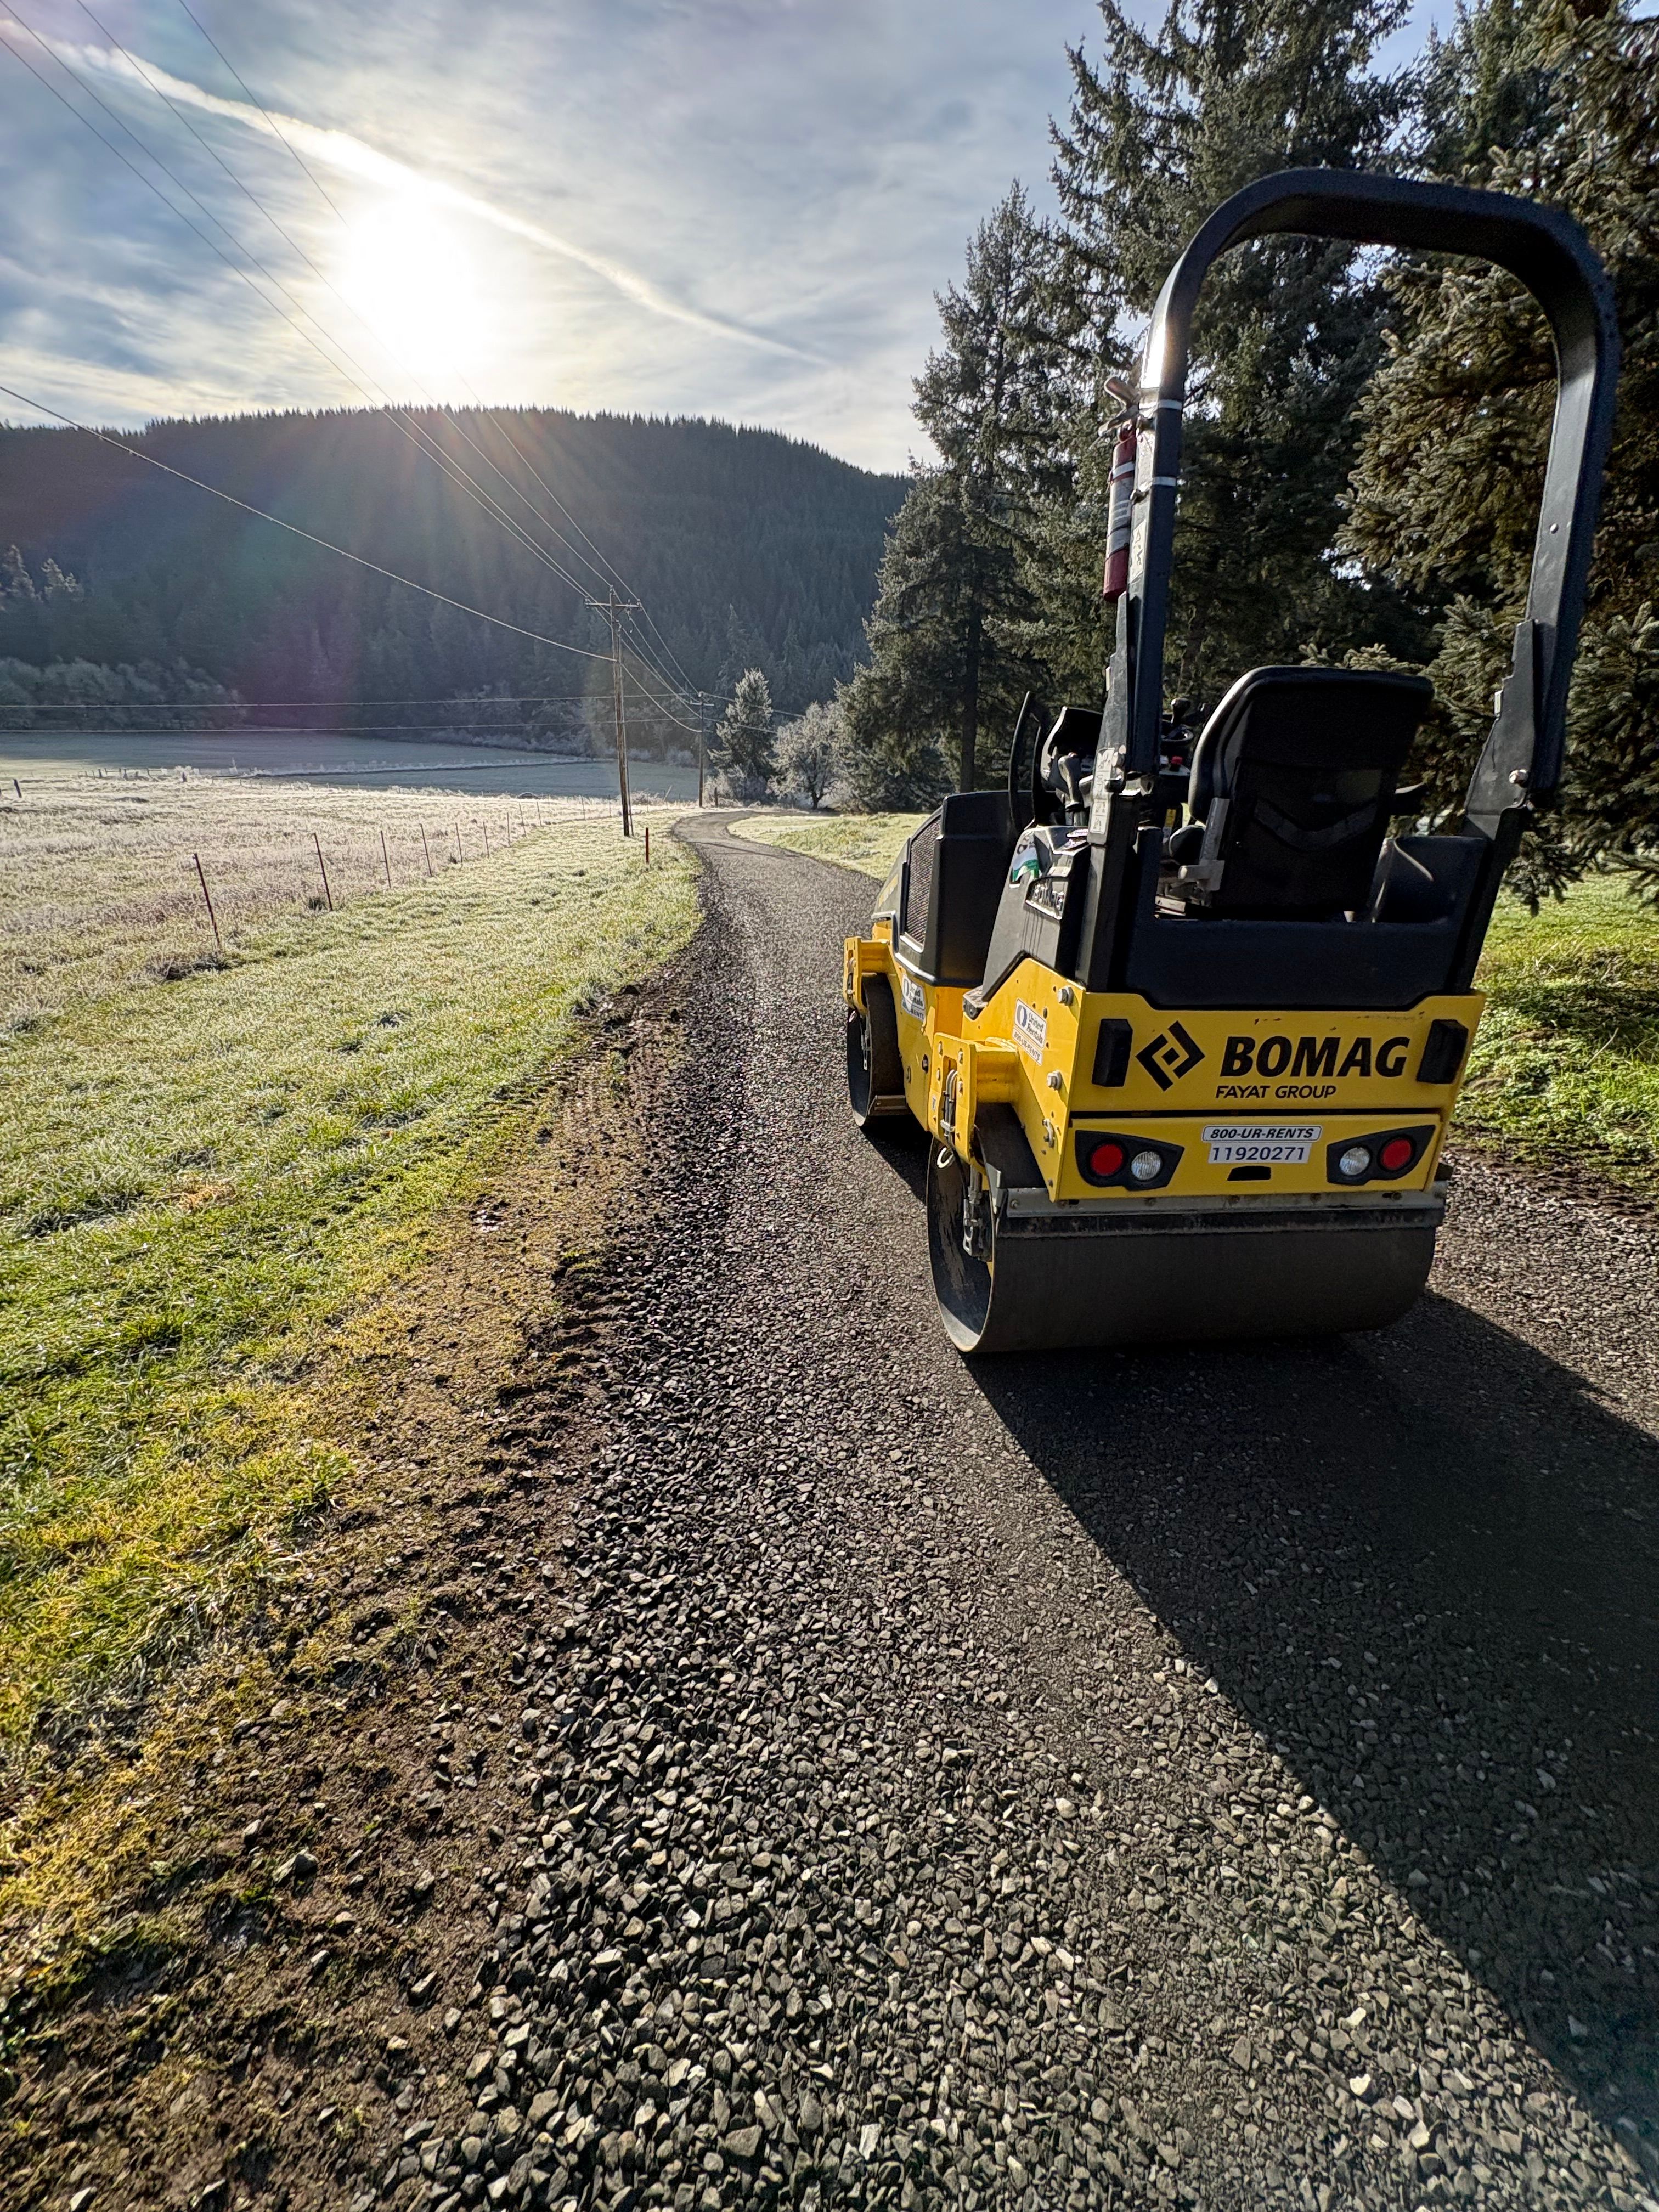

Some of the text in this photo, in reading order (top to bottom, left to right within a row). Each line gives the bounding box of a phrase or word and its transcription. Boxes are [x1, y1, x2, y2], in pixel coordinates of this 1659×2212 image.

[1028, 1012, 1044, 1032] United
[1026, 1023, 1043, 1044] Rentals
[1220, 1036, 1410, 1077] BOMAG
[1215, 1085, 1336, 1098] FAYAT GROUP
[1210, 1128, 1314, 1138] 800-UR-RENTS
[1212, 1147, 1305, 1160] 11920271
